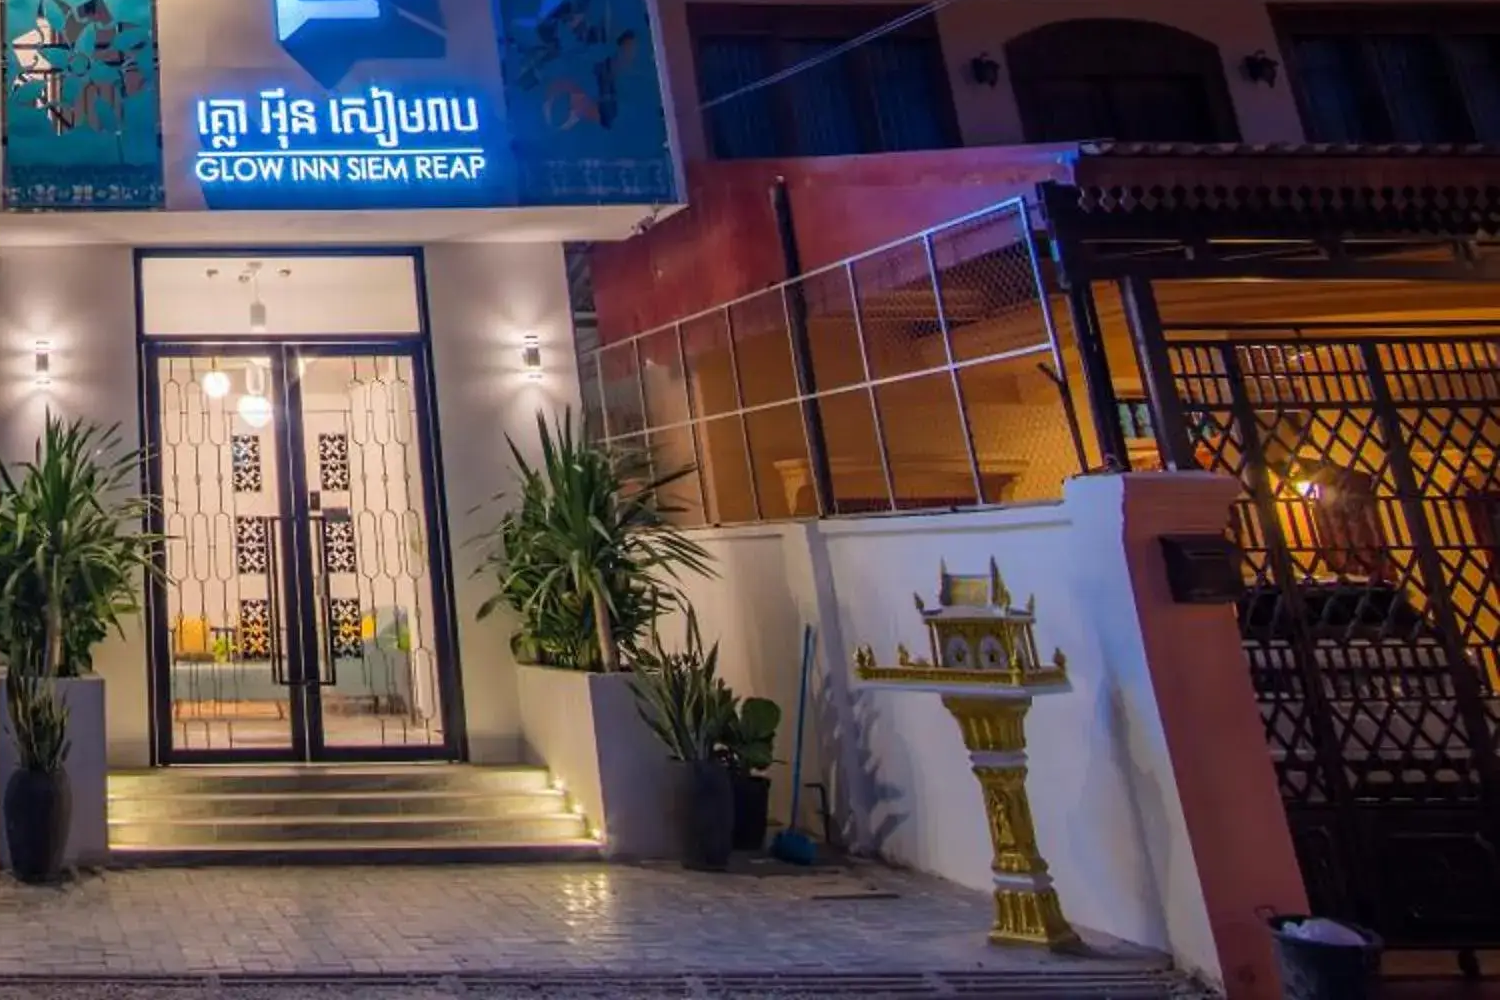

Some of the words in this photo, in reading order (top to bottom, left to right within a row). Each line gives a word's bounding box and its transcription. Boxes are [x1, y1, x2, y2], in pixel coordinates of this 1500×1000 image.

[329, 86, 479, 148] សៀមរាប
[195, 157, 284, 182] GLOW
[291, 156, 341, 181] INN
[346, 156, 408, 182] SIEM
[414, 154, 485, 180] REAP
